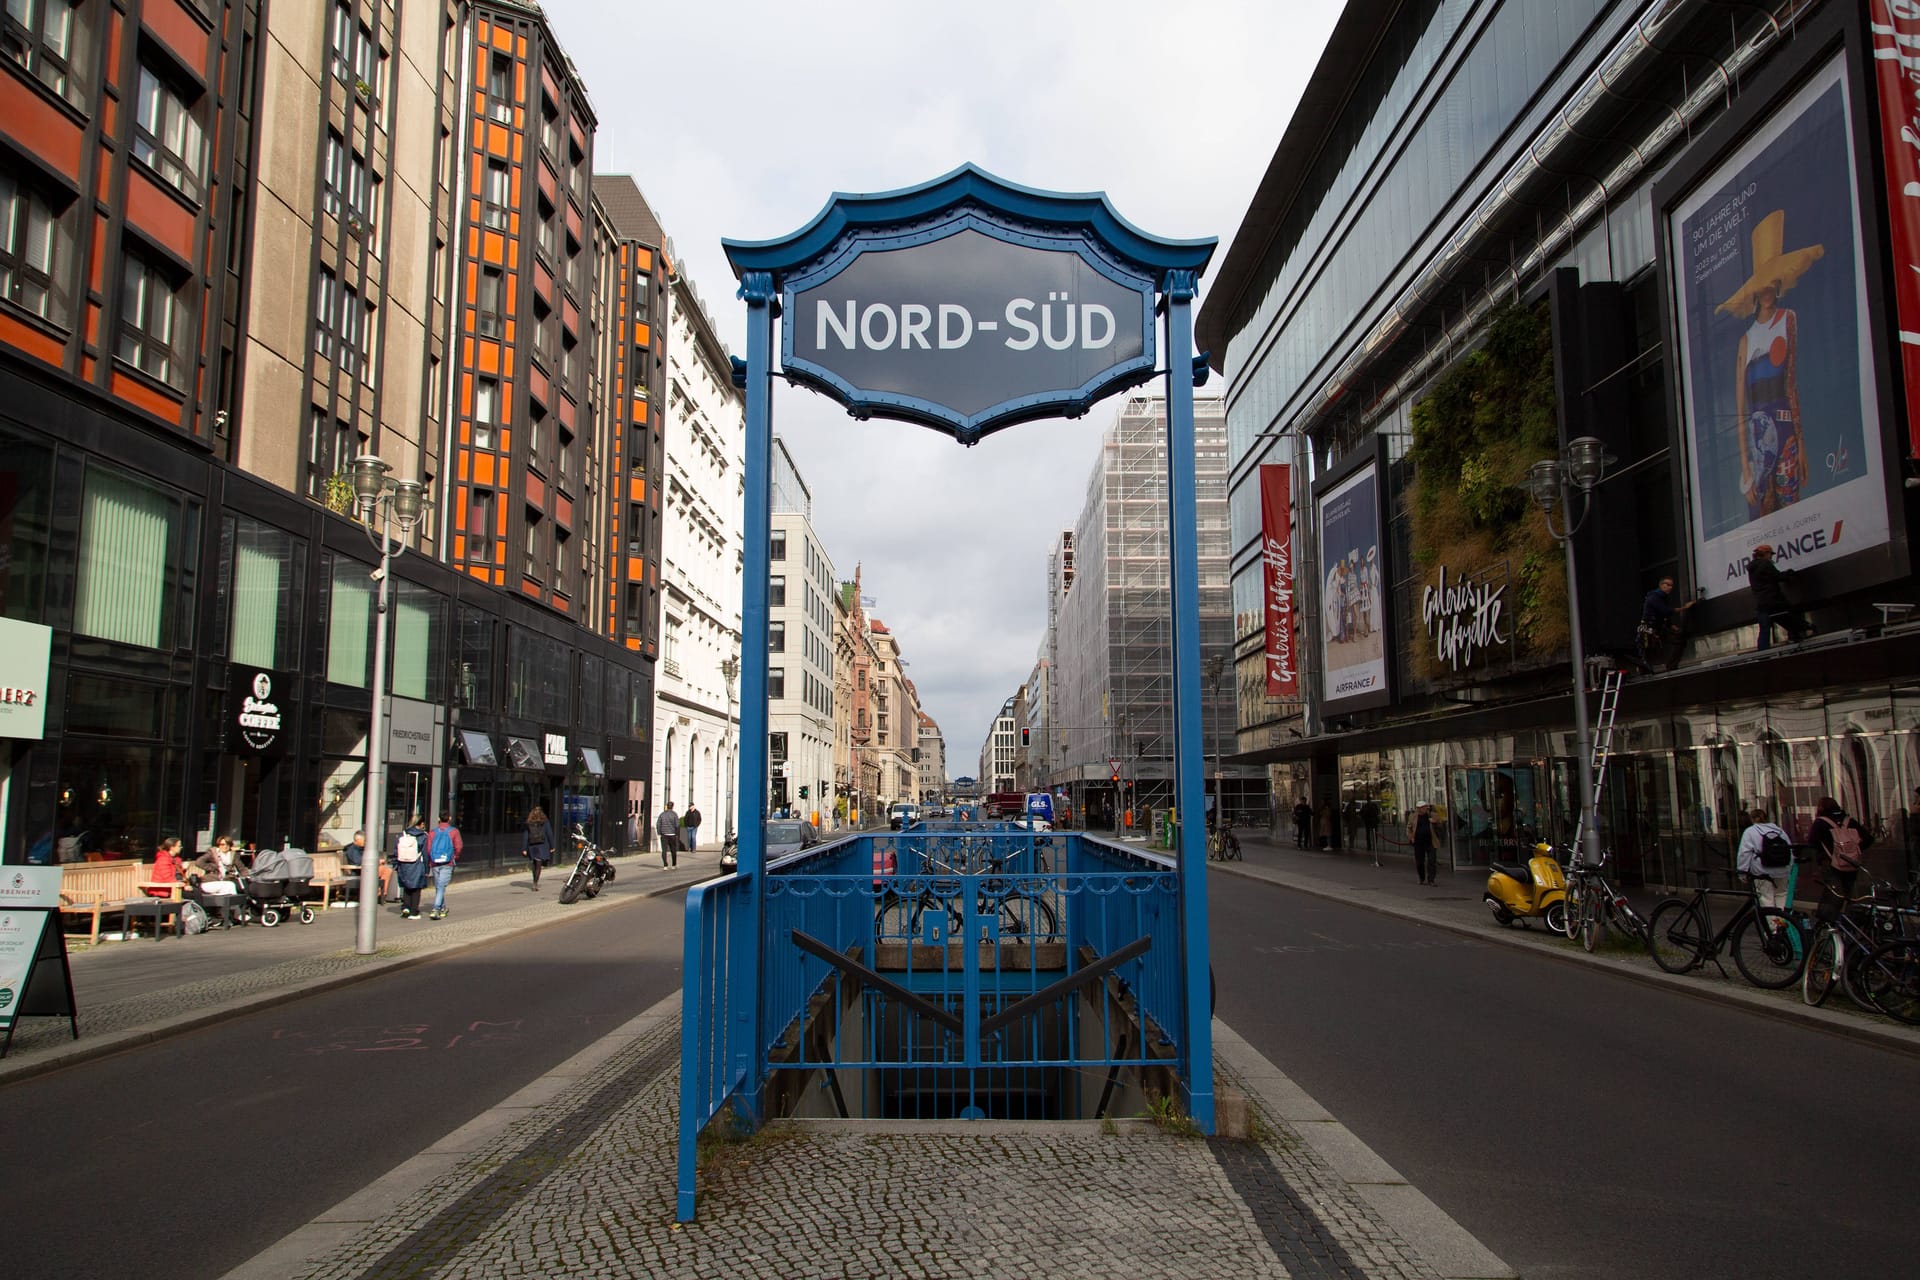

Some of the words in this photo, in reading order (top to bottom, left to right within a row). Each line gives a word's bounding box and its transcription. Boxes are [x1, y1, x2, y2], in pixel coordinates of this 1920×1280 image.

[1693, 226, 1704, 243] 90
[1705, 203, 1732, 234] JAHRE
[1732, 182, 1757, 208] RUND
[1694, 239, 1708, 257] UM
[1709, 226, 1723, 247] DIE
[1723, 206, 1750, 233] WELT.
[816, 292, 1116, 351] NORD-SÜD
[1263, 534, 1294, 613] Lafayette
[1727, 529, 1826, 581] AIRANCE
[1423, 565, 1476, 636] Galeries
[1437, 584, 1509, 671] Lafayette
[1265, 616, 1296, 683] Galeries
[0, 688, 34, 706] ERZ
[1336, 677, 1370, 694] AIRFRANCE
[407, 744, 417, 755] 172
